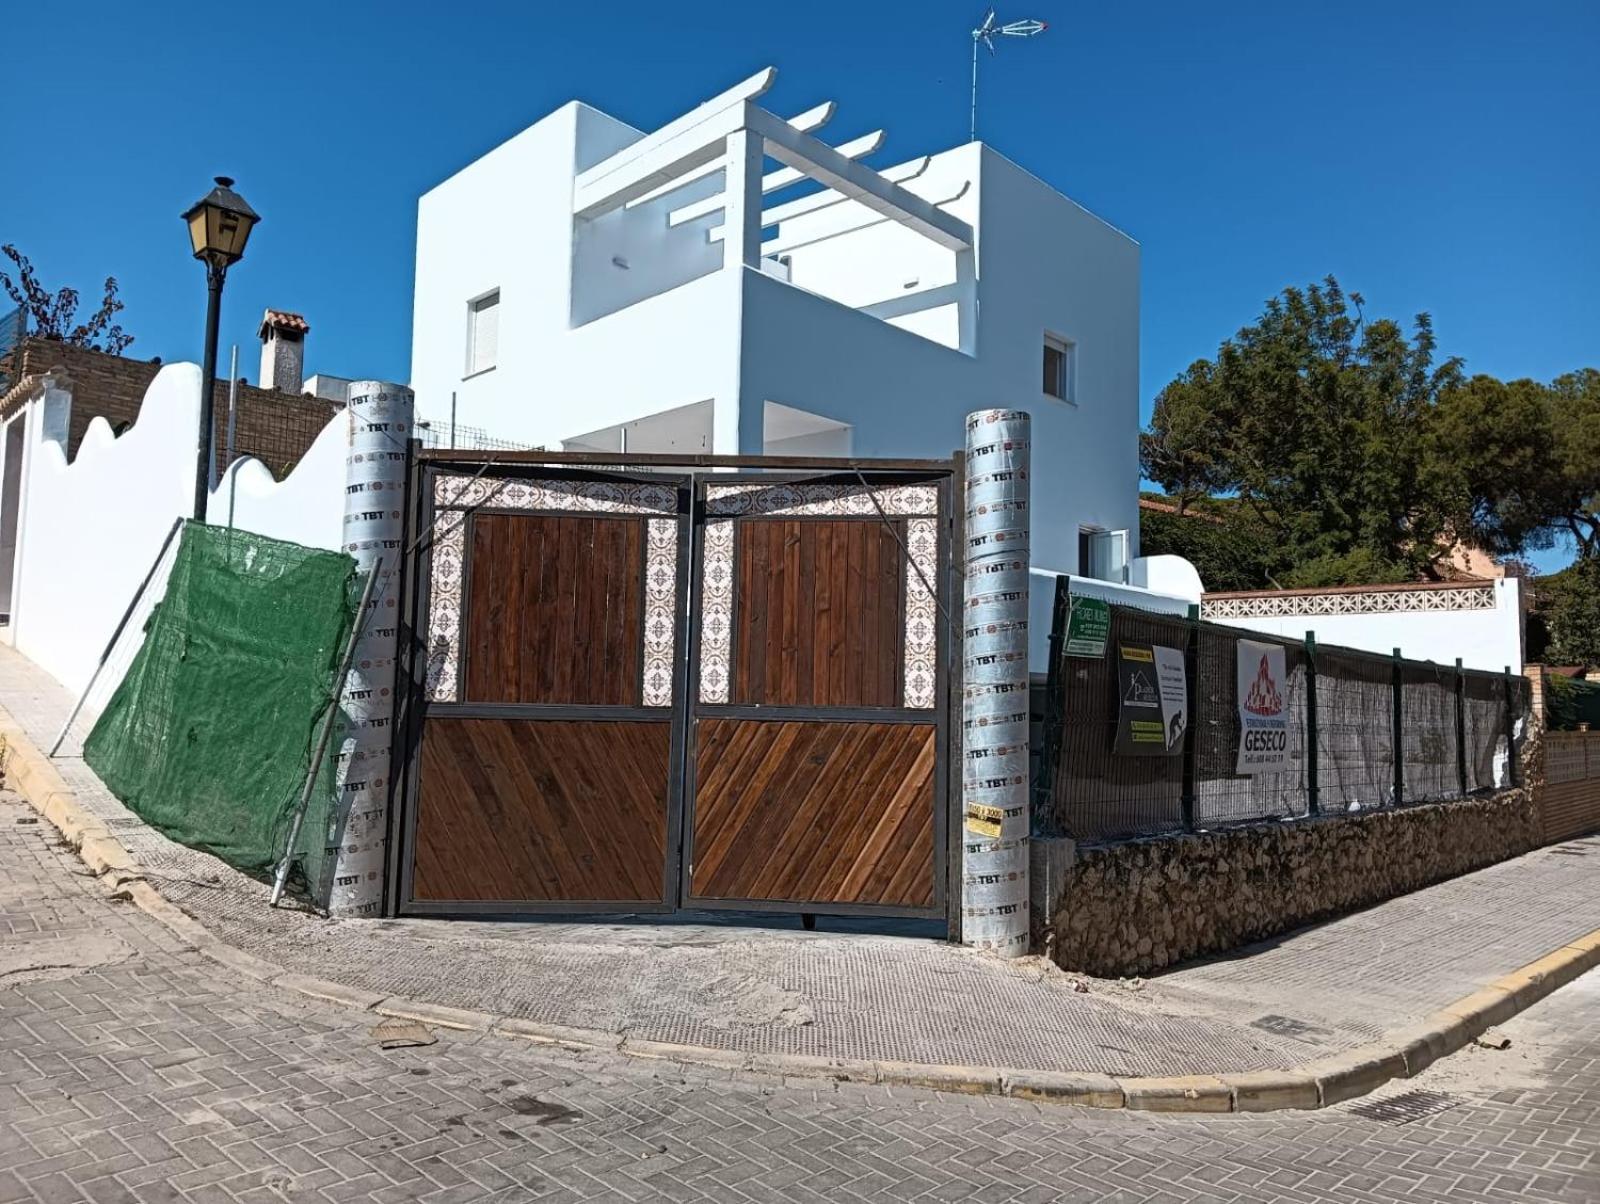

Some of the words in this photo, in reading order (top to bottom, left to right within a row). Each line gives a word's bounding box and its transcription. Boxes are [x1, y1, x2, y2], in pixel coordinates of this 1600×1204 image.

[351, 394, 369, 406] TBT
[367, 423, 390, 432] TBT
[975, 444, 996, 456] TBT
[387, 452, 406, 461] TBT
[992, 472, 1014, 481] TBT
[346, 483, 365, 494] TBT
[361, 511, 384, 520] TBT
[382, 540, 400, 549] TBT
[970, 536, 988, 547] TBT
[985, 563, 1006, 573] TBT
[1002, 592, 1021, 601] TBT
[376, 628, 395, 637] TBT
[976, 655, 997, 665] TBT
[993, 683, 1015, 693] TBT
[349, 689, 373, 700] TBT
[1011, 712, 1027, 722] TBT
[369, 718, 389, 728] TBT
[1245, 730, 1286, 751] GESECO
[970, 749, 989, 759] TBT
[343, 781, 367, 792] TBT
[985, 778, 1007, 788] TBT
[1004, 807, 1024, 818] TBT
[336, 875, 360, 886] TBT
[978, 874, 1000, 885] TBT
[996, 904, 1018, 915] TBT
